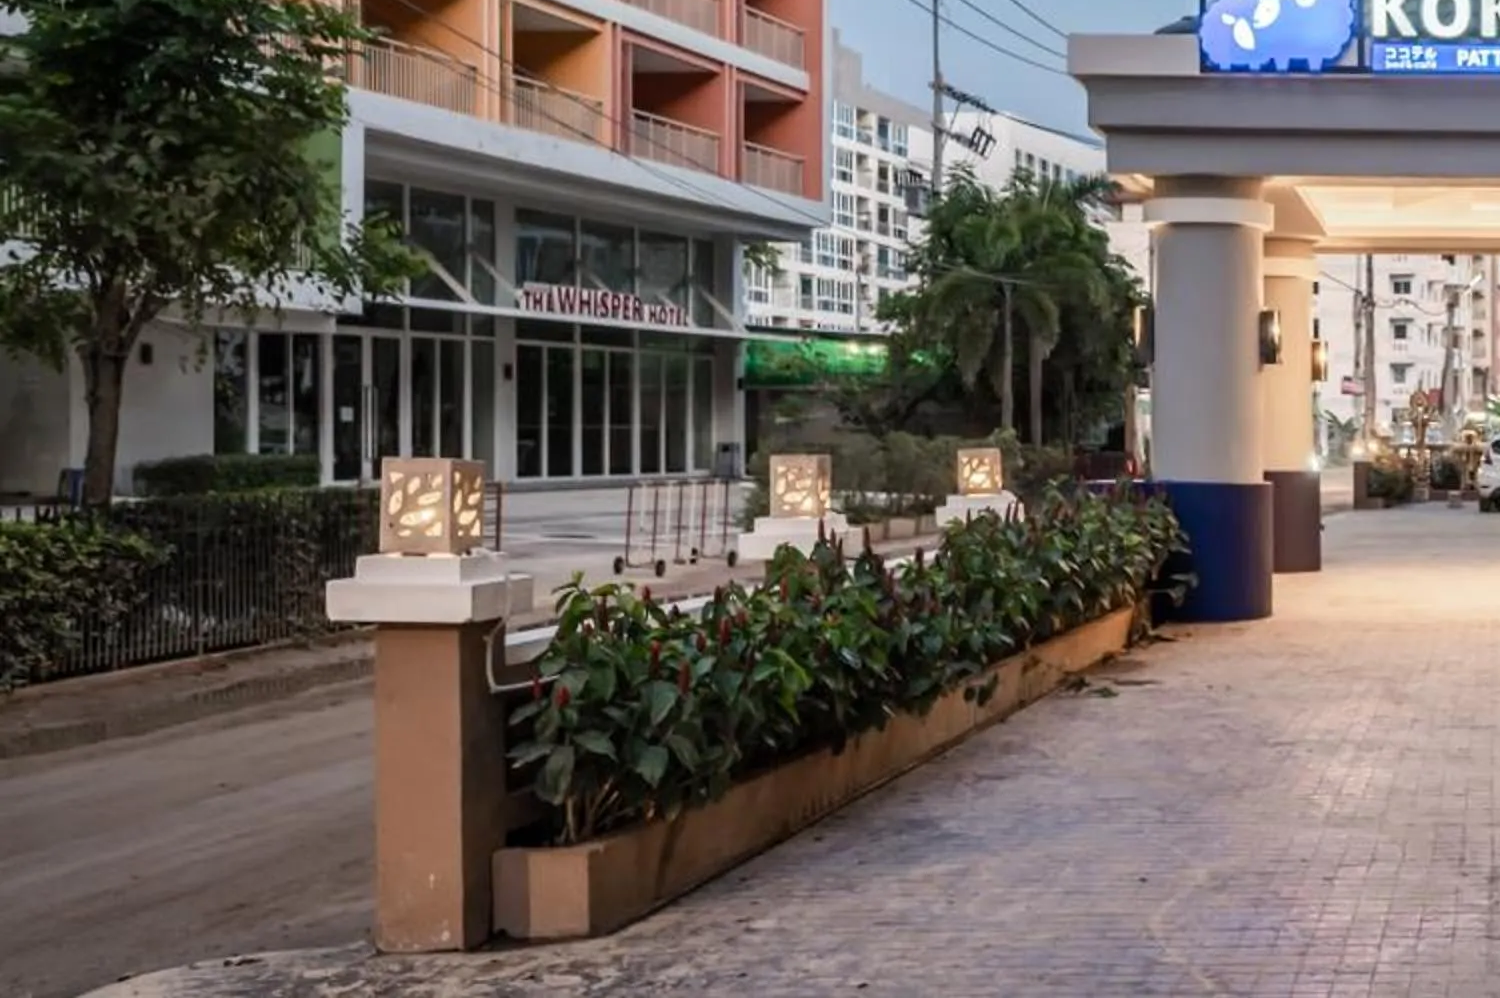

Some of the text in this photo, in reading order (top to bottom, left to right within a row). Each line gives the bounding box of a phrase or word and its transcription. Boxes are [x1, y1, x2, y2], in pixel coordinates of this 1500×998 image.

[523, 287, 689, 328] THE WHISPER HOTEL
